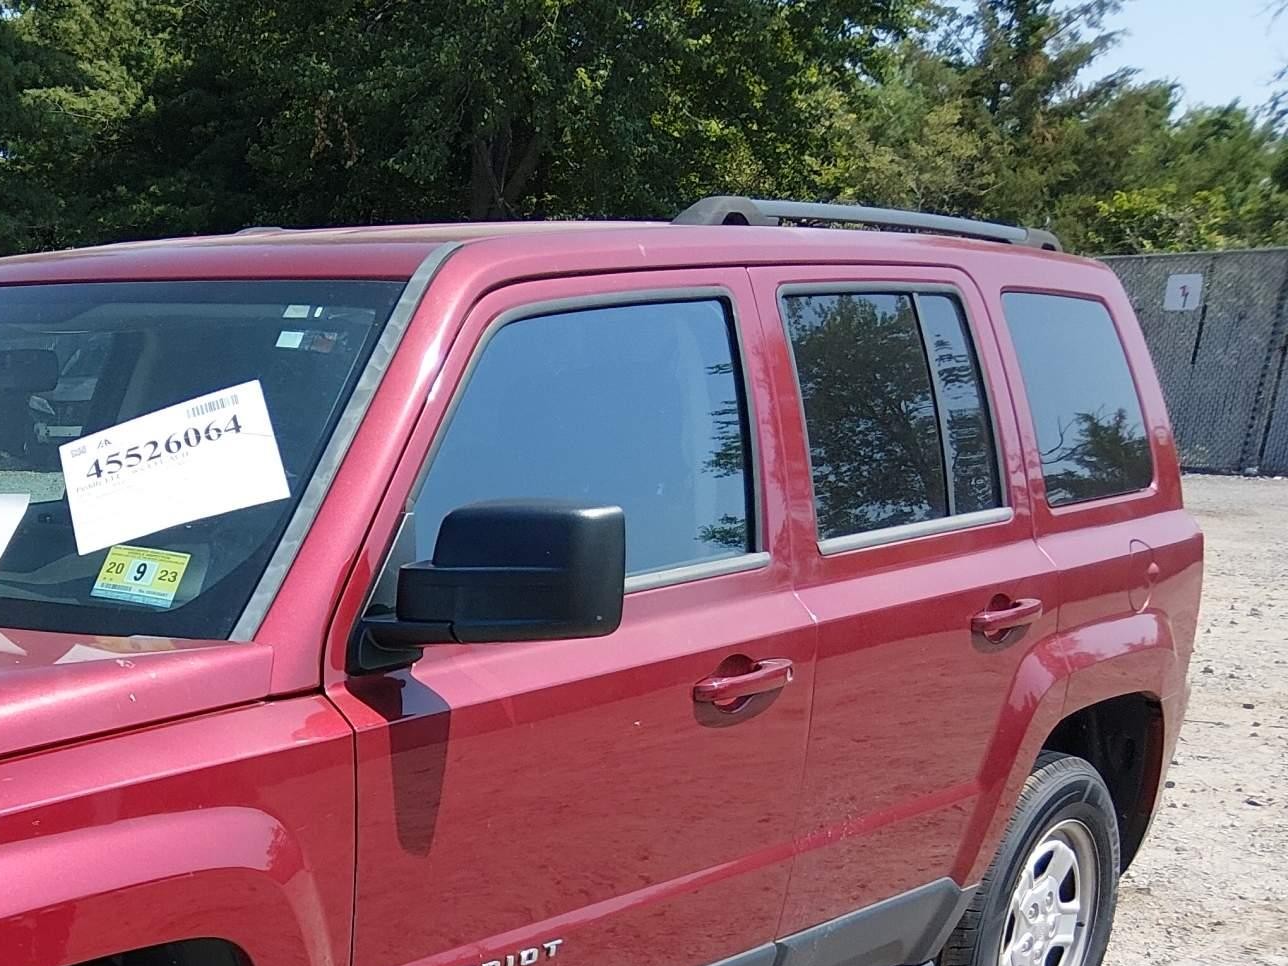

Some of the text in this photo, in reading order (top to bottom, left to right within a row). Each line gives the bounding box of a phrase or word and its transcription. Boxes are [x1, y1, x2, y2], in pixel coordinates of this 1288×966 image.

[86, 413, 243, 480] 45526064
[106, 561, 178, 583] 20 9 23
